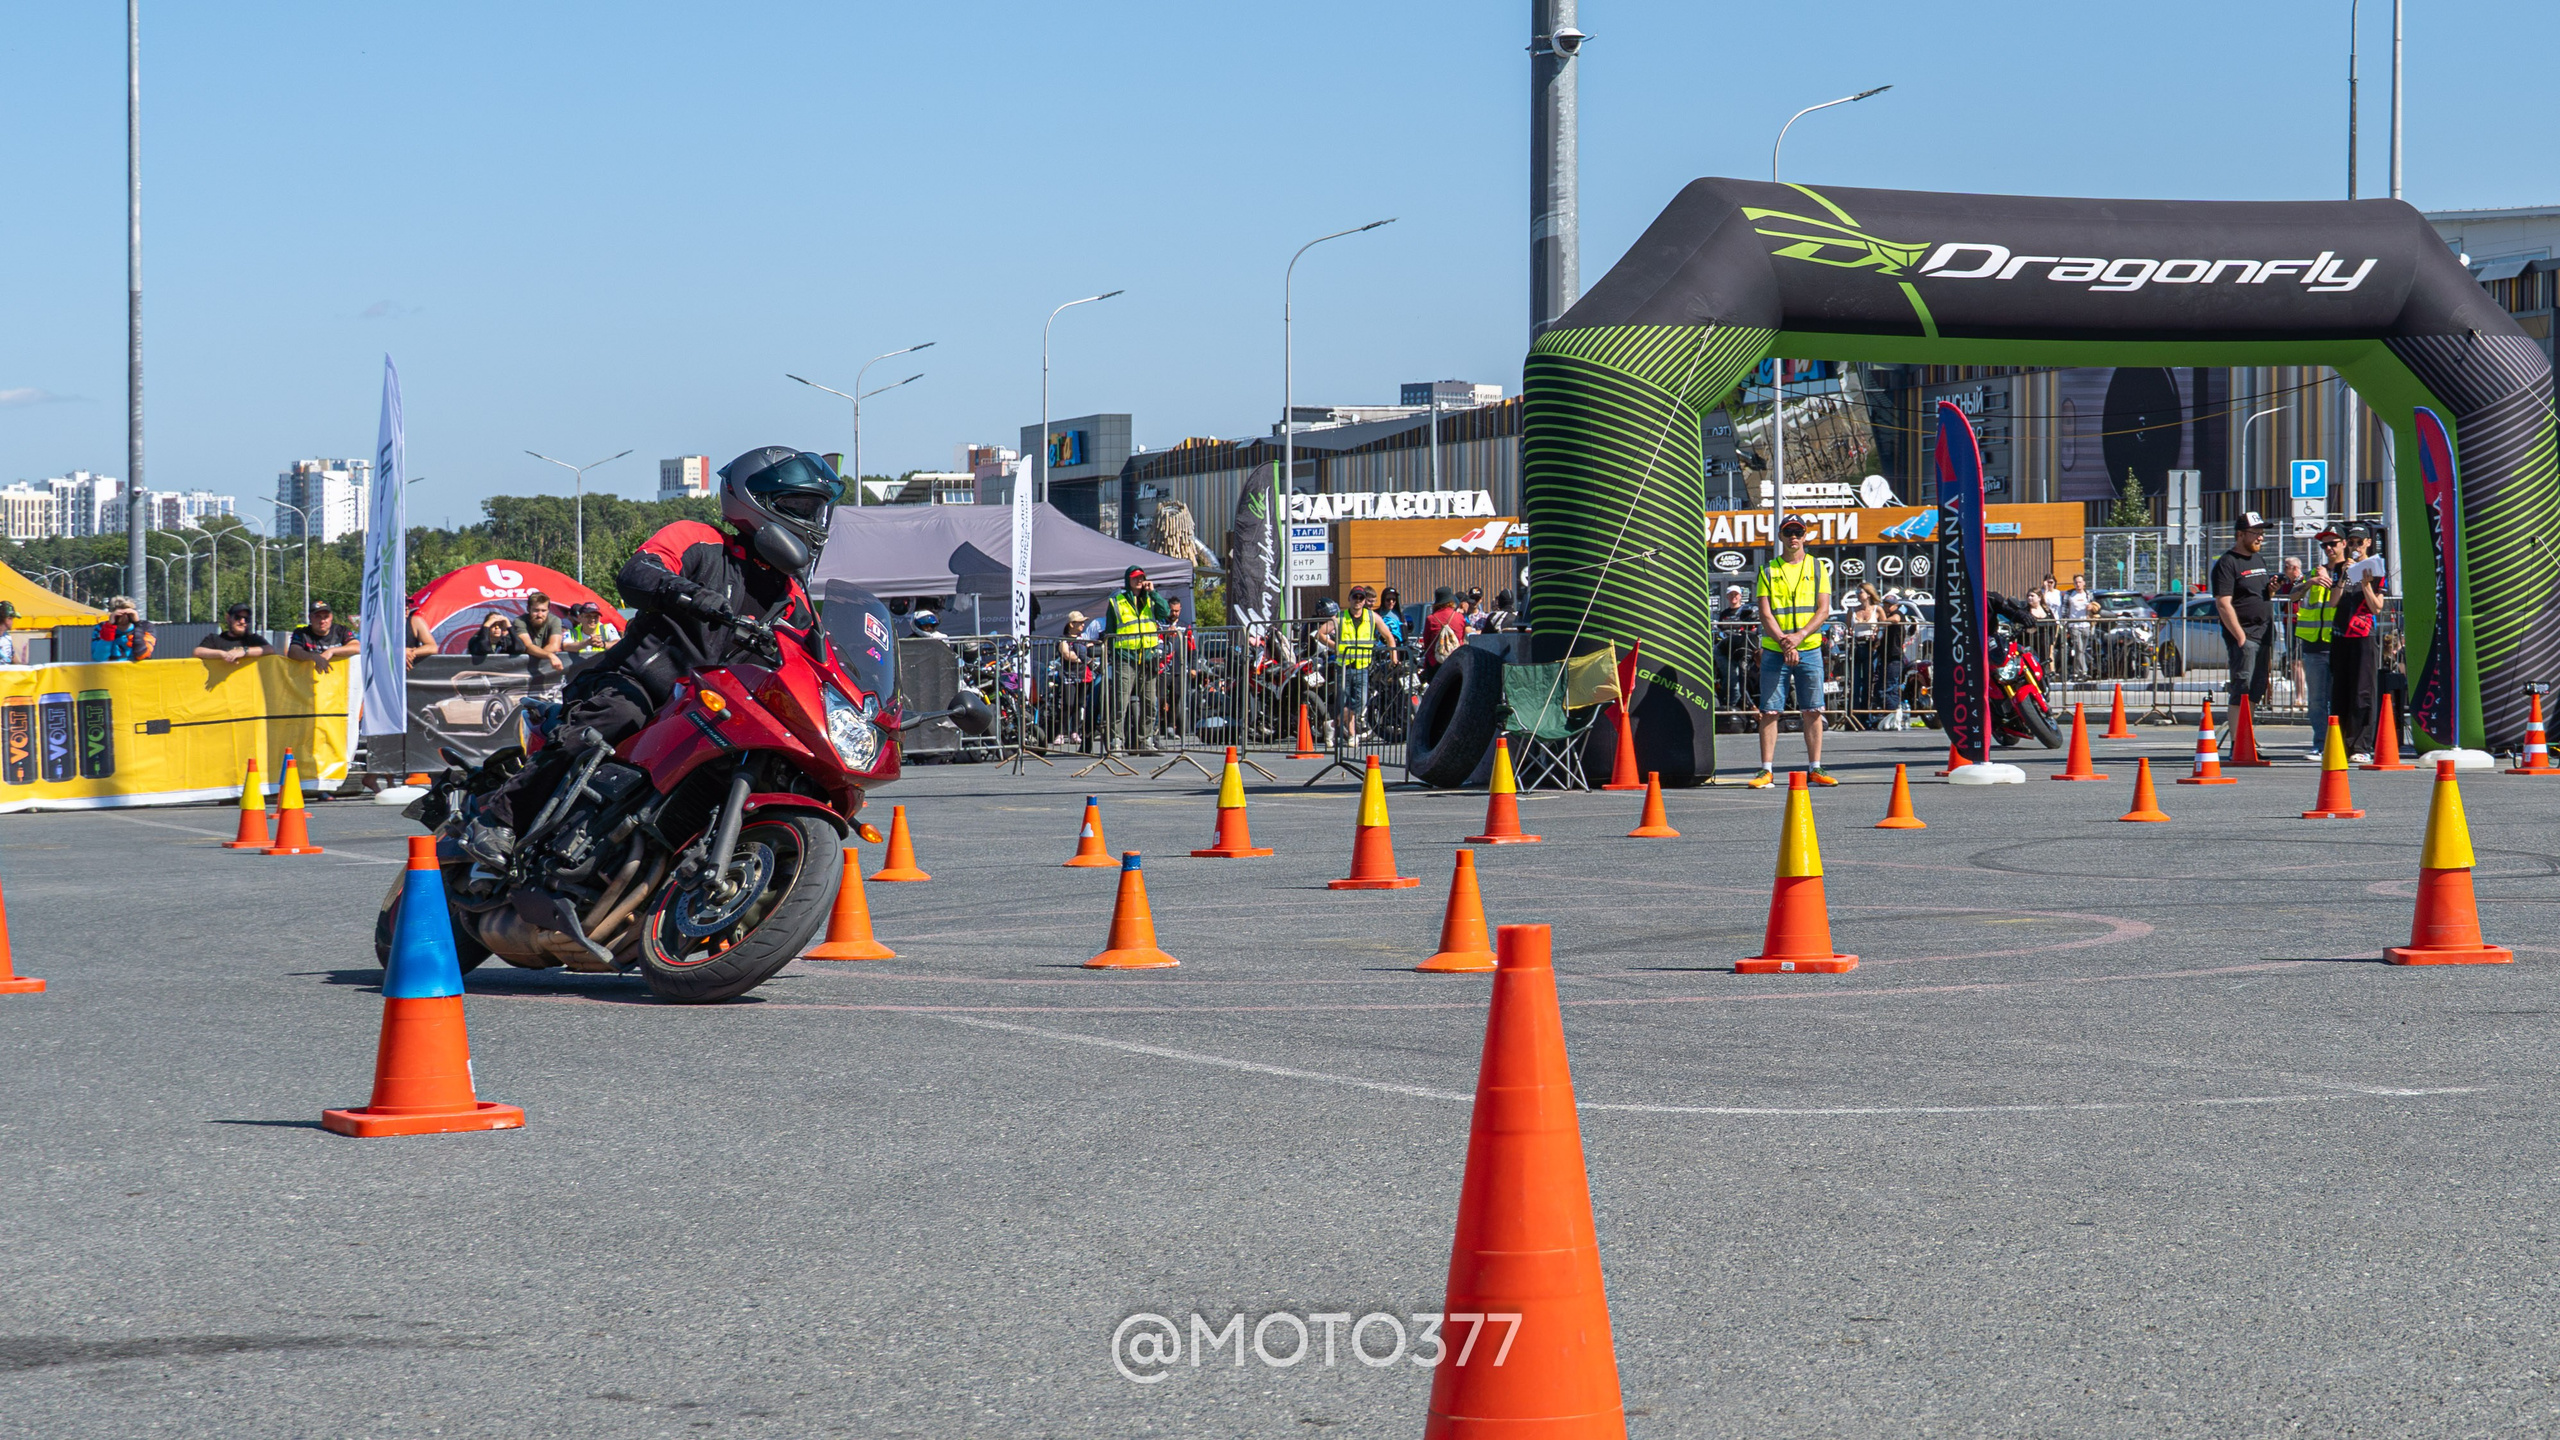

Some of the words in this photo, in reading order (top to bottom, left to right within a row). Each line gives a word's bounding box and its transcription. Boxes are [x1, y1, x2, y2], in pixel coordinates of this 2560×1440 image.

[1919, 243, 2378, 292] Dragonfly
[2300, 464, 2321, 494] P
[1291, 528, 1324, 537] .ТАГИЛ
[1292, 543, 1317, 551] ЕРМЬ
[1705, 512, 1858, 544] АПЧСТИ
[1293, 573, 1322, 581] ОКЗАЛ
[1944, 494, 1969, 750] MOTOGYMKHANA
[1634, 666, 1709, 710] GONFLY.SU
[9, 711, 29, 765] VOLT
[48, 708, 68, 761] VOLT
[86, 705, 105, 758] VOLT
